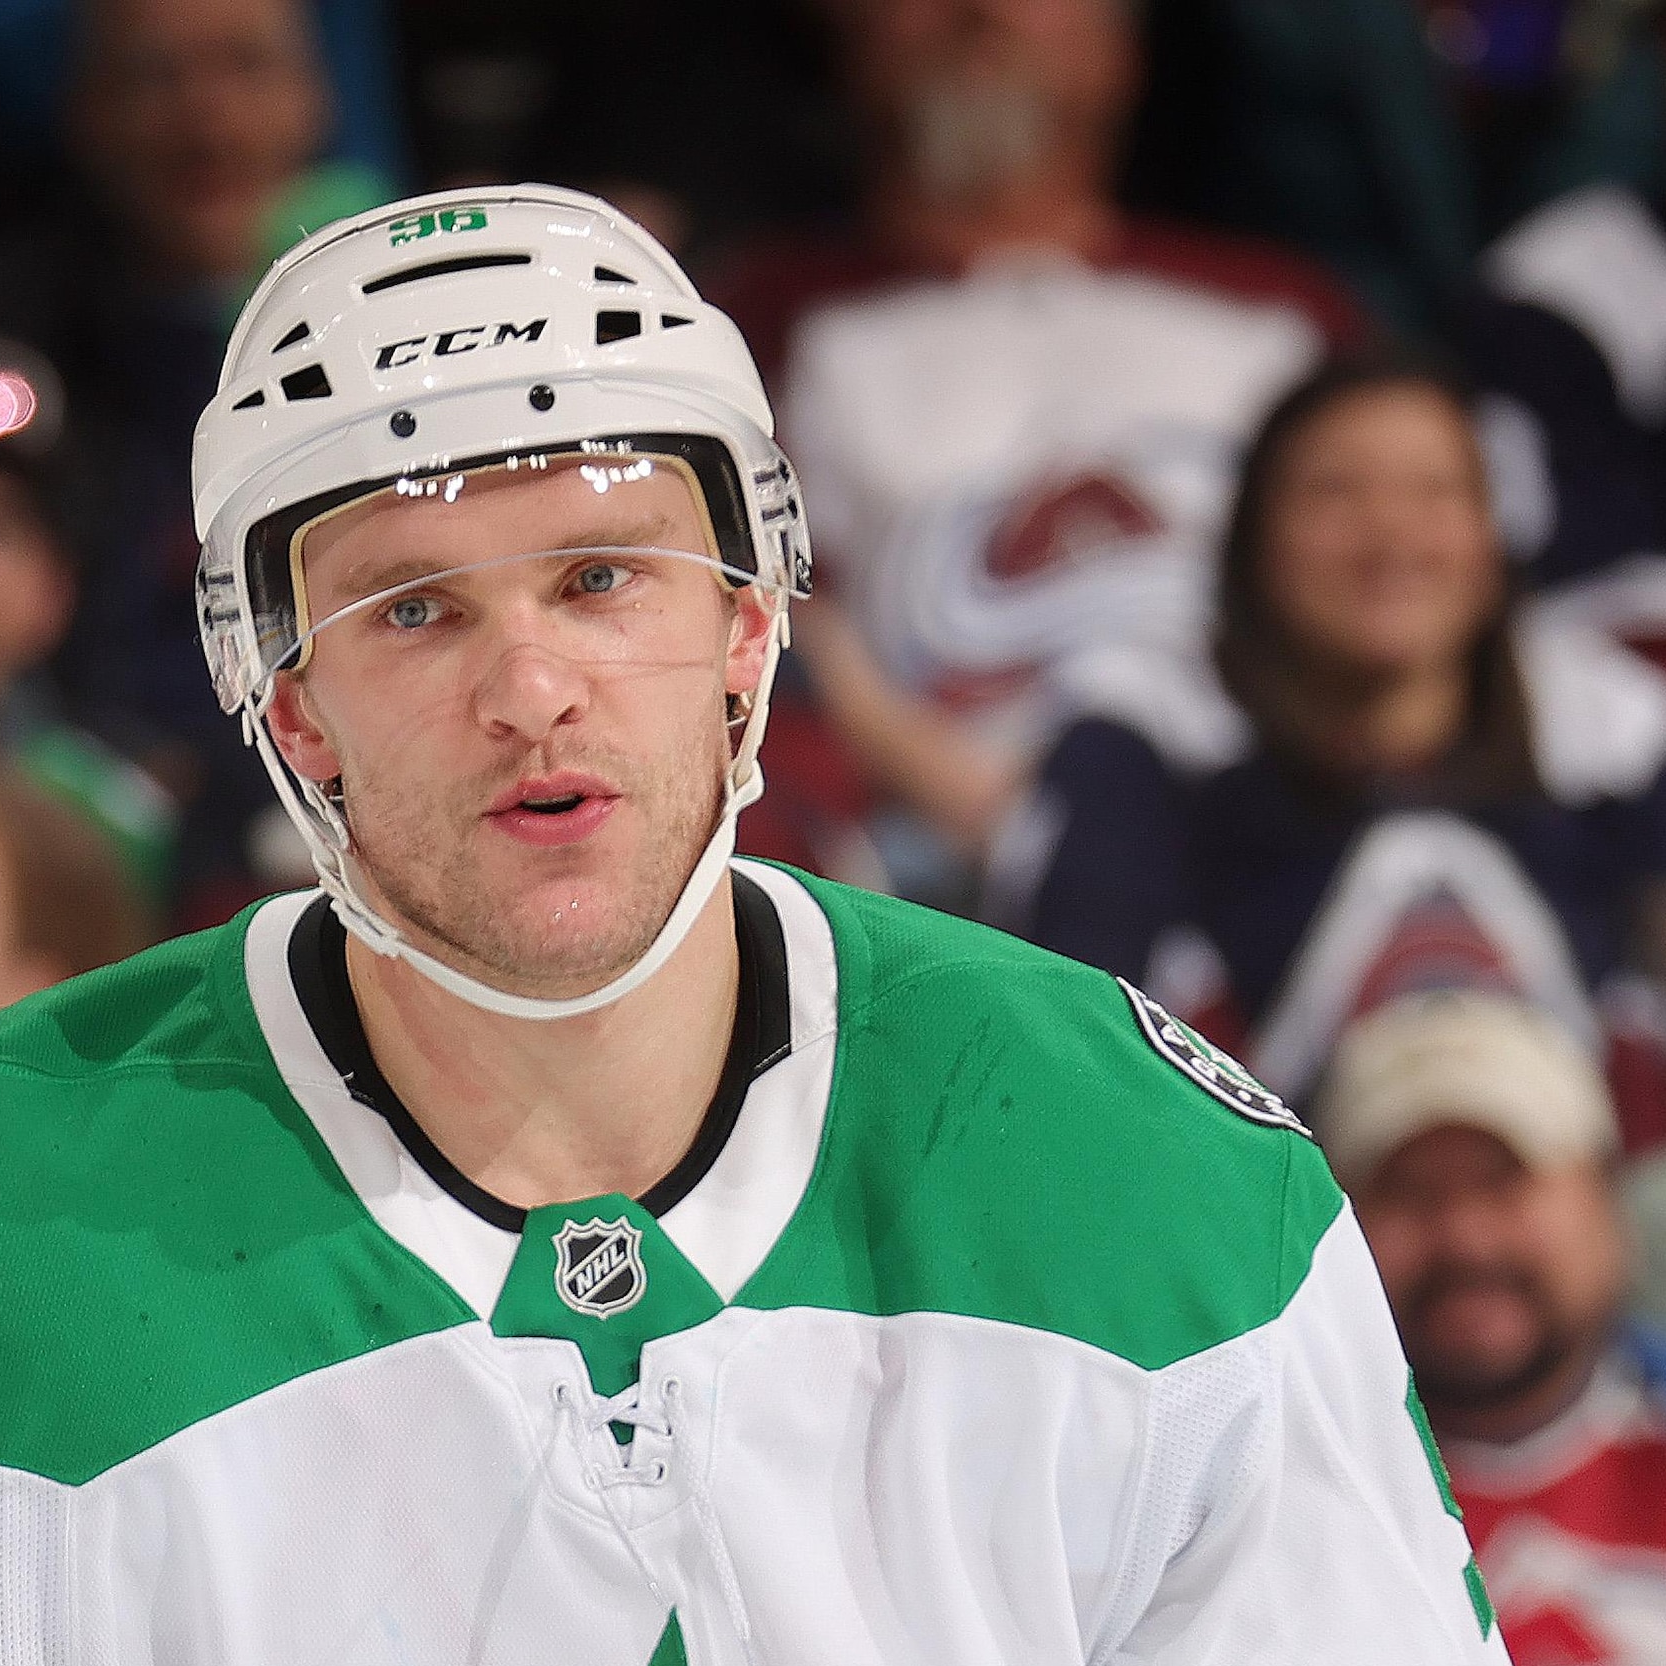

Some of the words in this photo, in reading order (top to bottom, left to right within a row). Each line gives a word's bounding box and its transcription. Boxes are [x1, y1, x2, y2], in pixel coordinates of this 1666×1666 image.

[389, 207, 489, 247] 96
[374, 316, 549, 371] CCM
[576, 1243, 626, 1297] NHL
